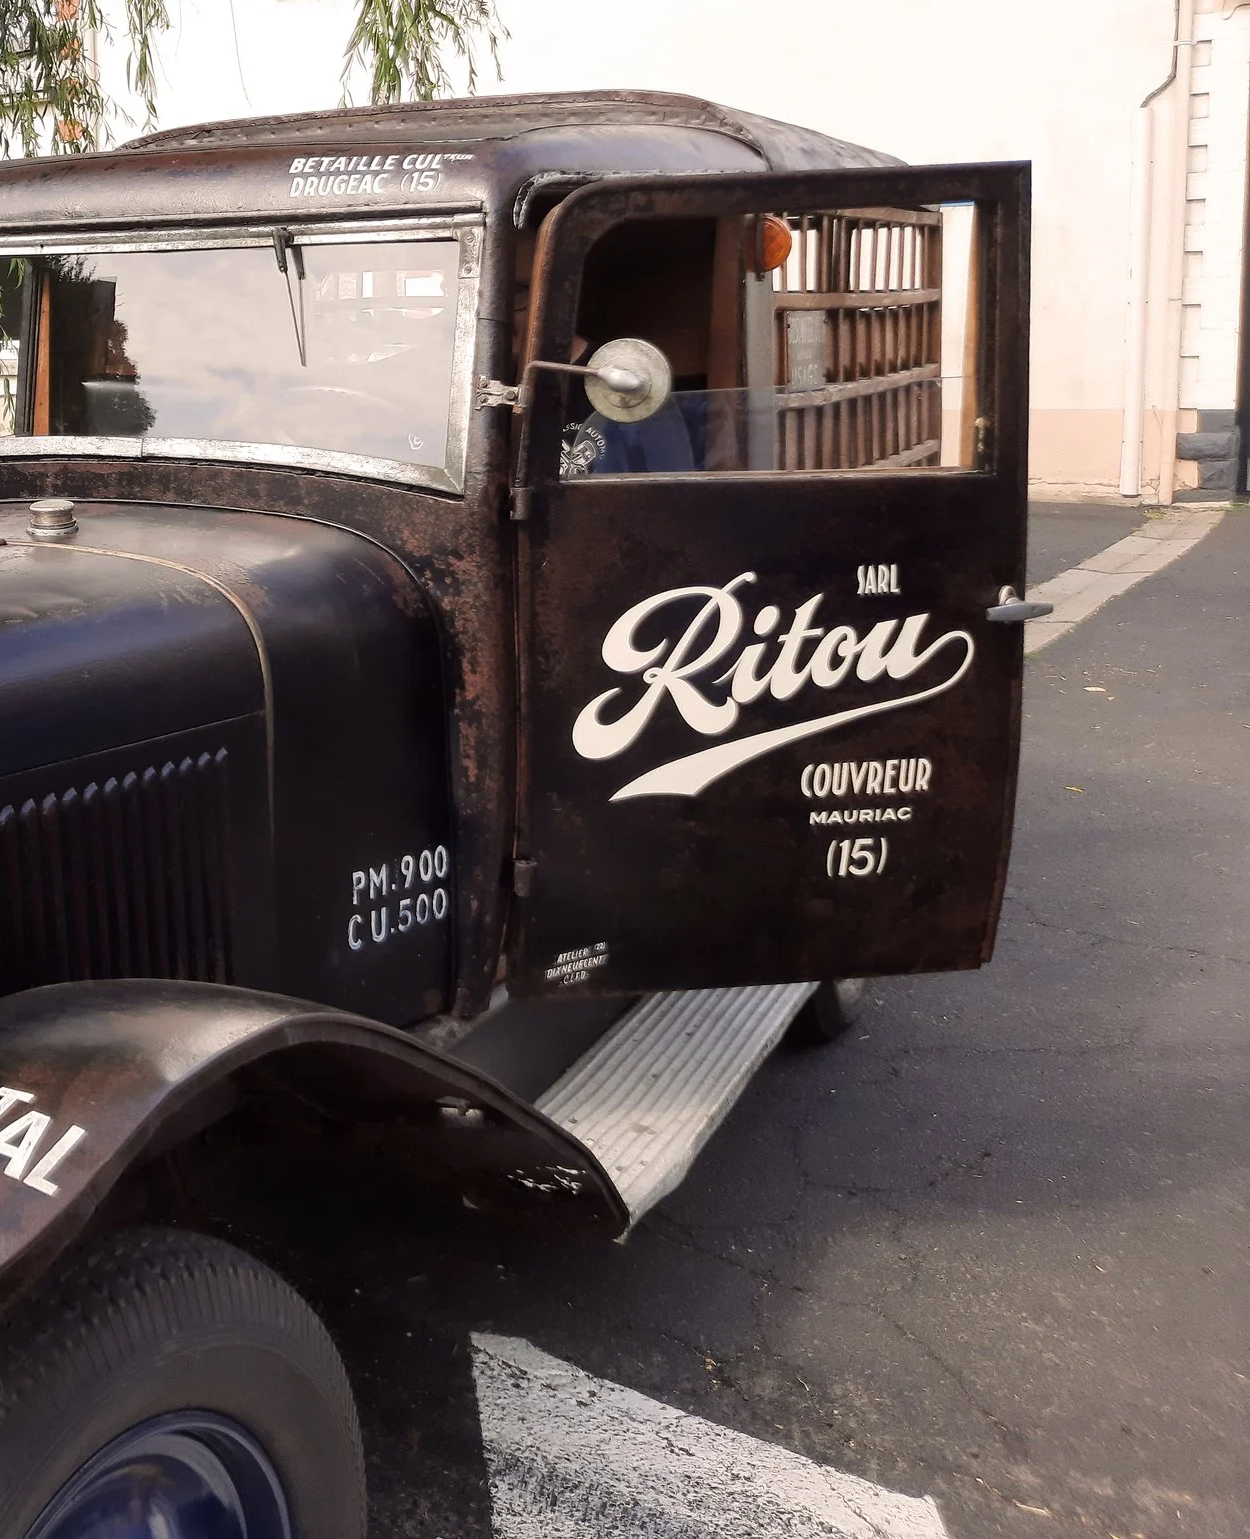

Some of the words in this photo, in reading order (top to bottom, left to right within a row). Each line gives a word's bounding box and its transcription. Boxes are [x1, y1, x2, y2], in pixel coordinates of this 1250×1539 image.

[289, 155, 400, 174] BETAILLE
[290, 173, 388, 197] DRUGEAC
[401, 171, 442, 193] (15)
[857, 564, 900, 596] SARL
[572, 571, 975, 801] Ritou
[801, 758, 932, 798] COUVREUR
[809, 806, 913, 825] MAURIAC
[826, 837, 888, 878] (15)
